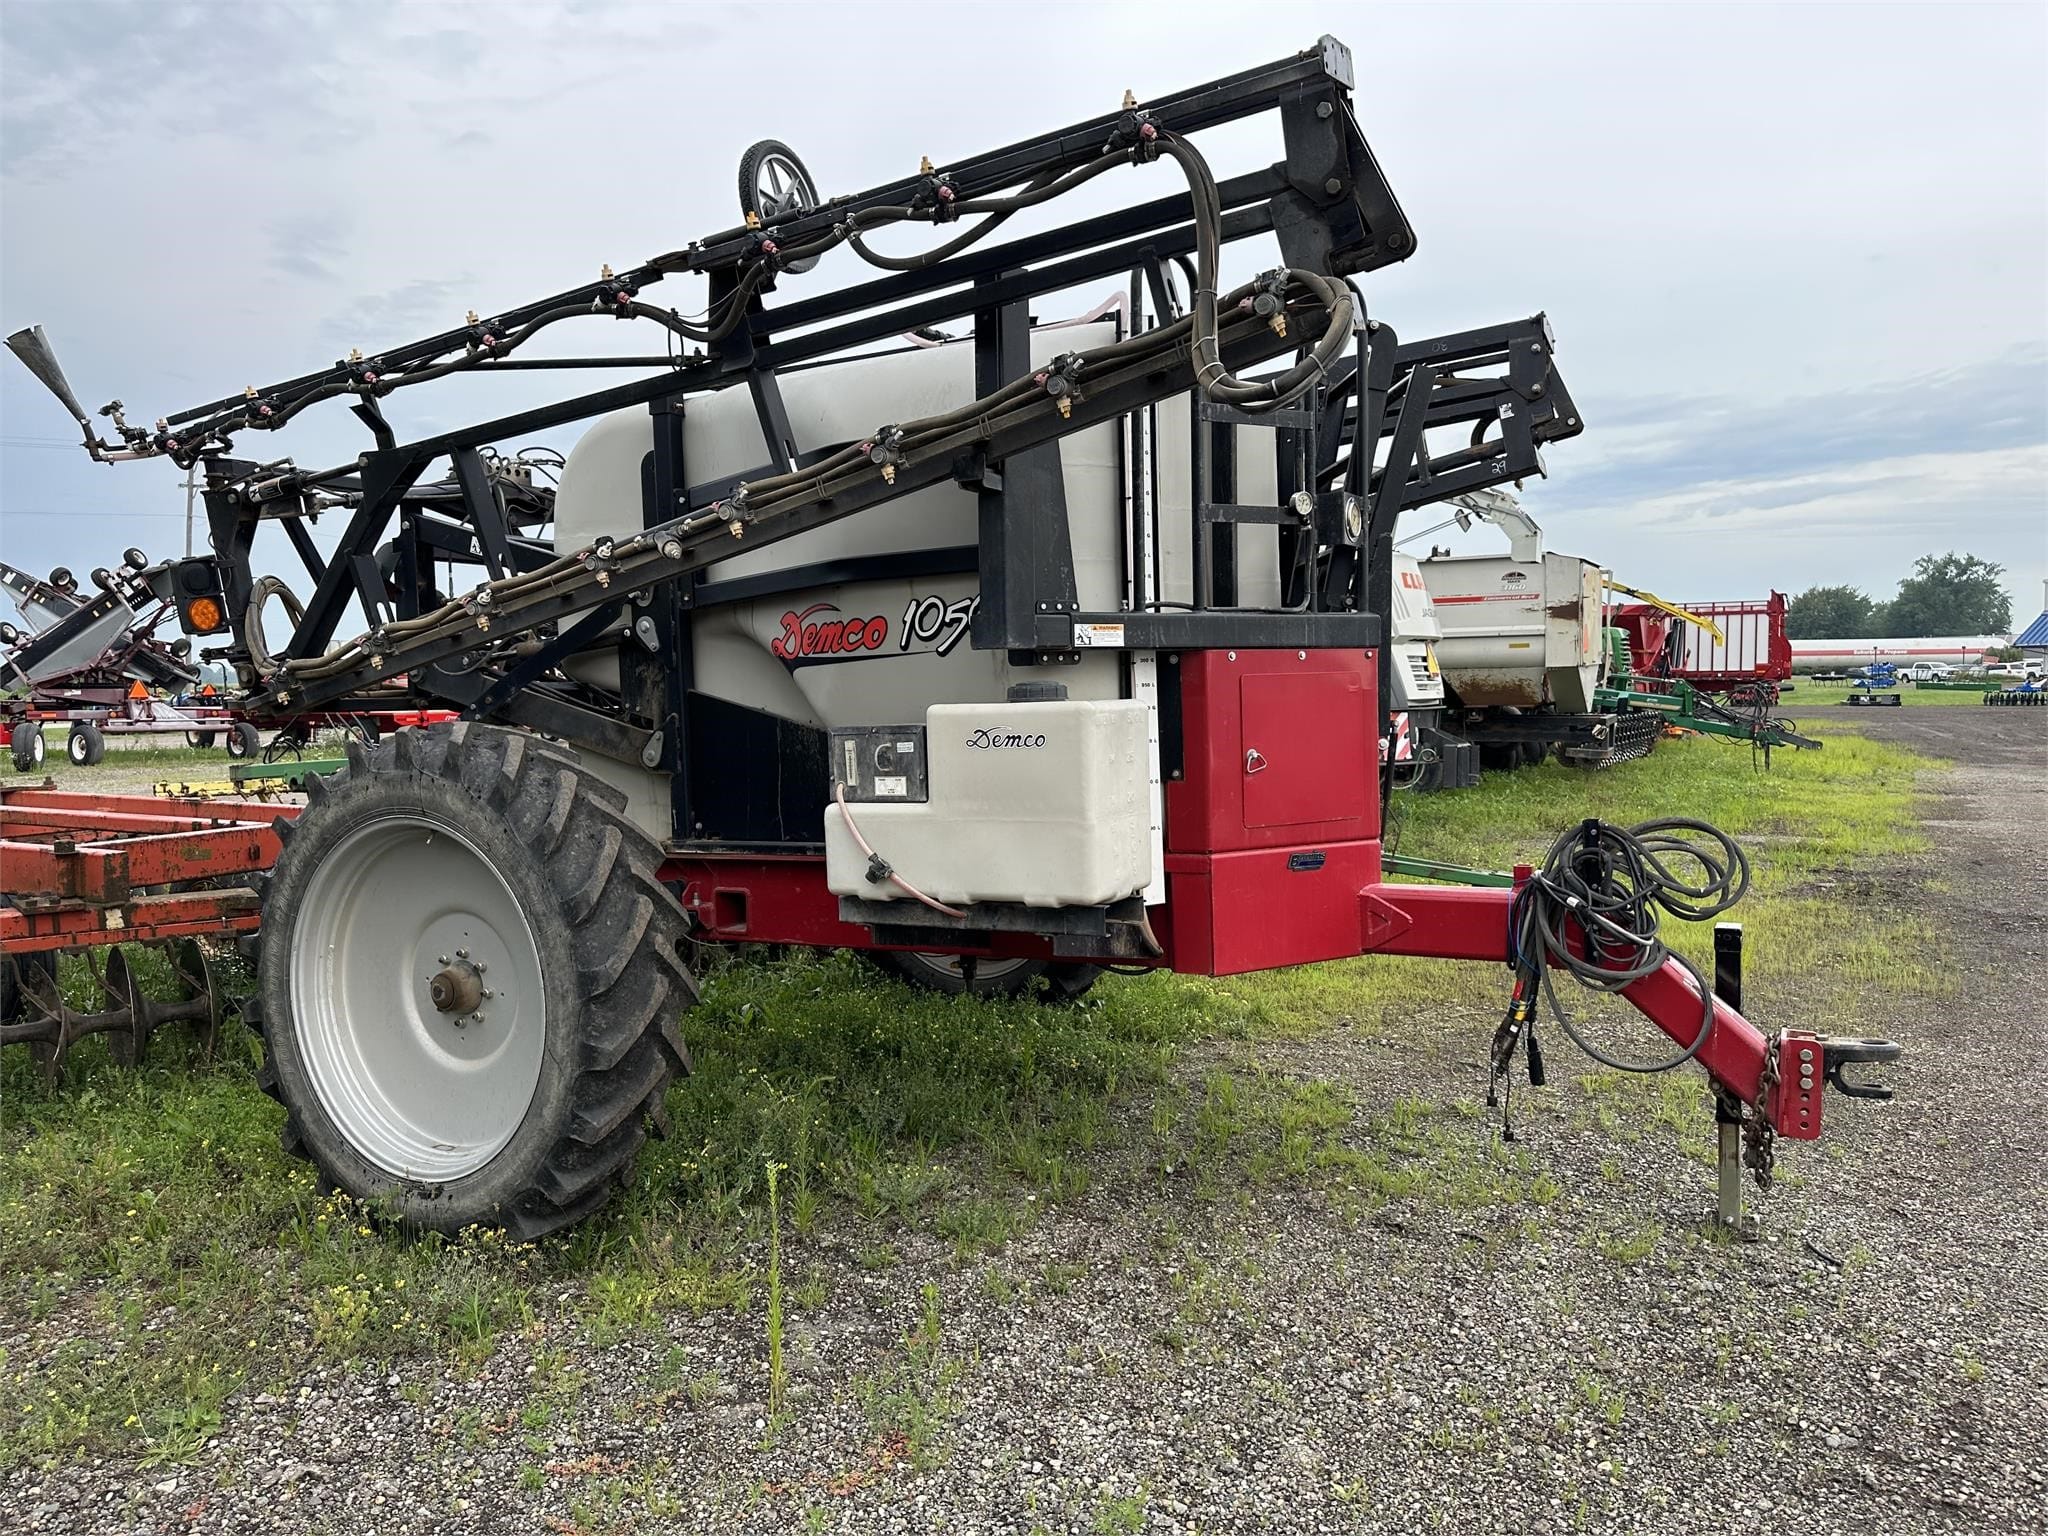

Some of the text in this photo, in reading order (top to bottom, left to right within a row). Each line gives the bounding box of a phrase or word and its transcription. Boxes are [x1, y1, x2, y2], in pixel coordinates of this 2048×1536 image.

[1491, 460, 1507, 475] 29
[771, 602, 889, 660] Demco
[966, 727, 1046, 749] Demco
